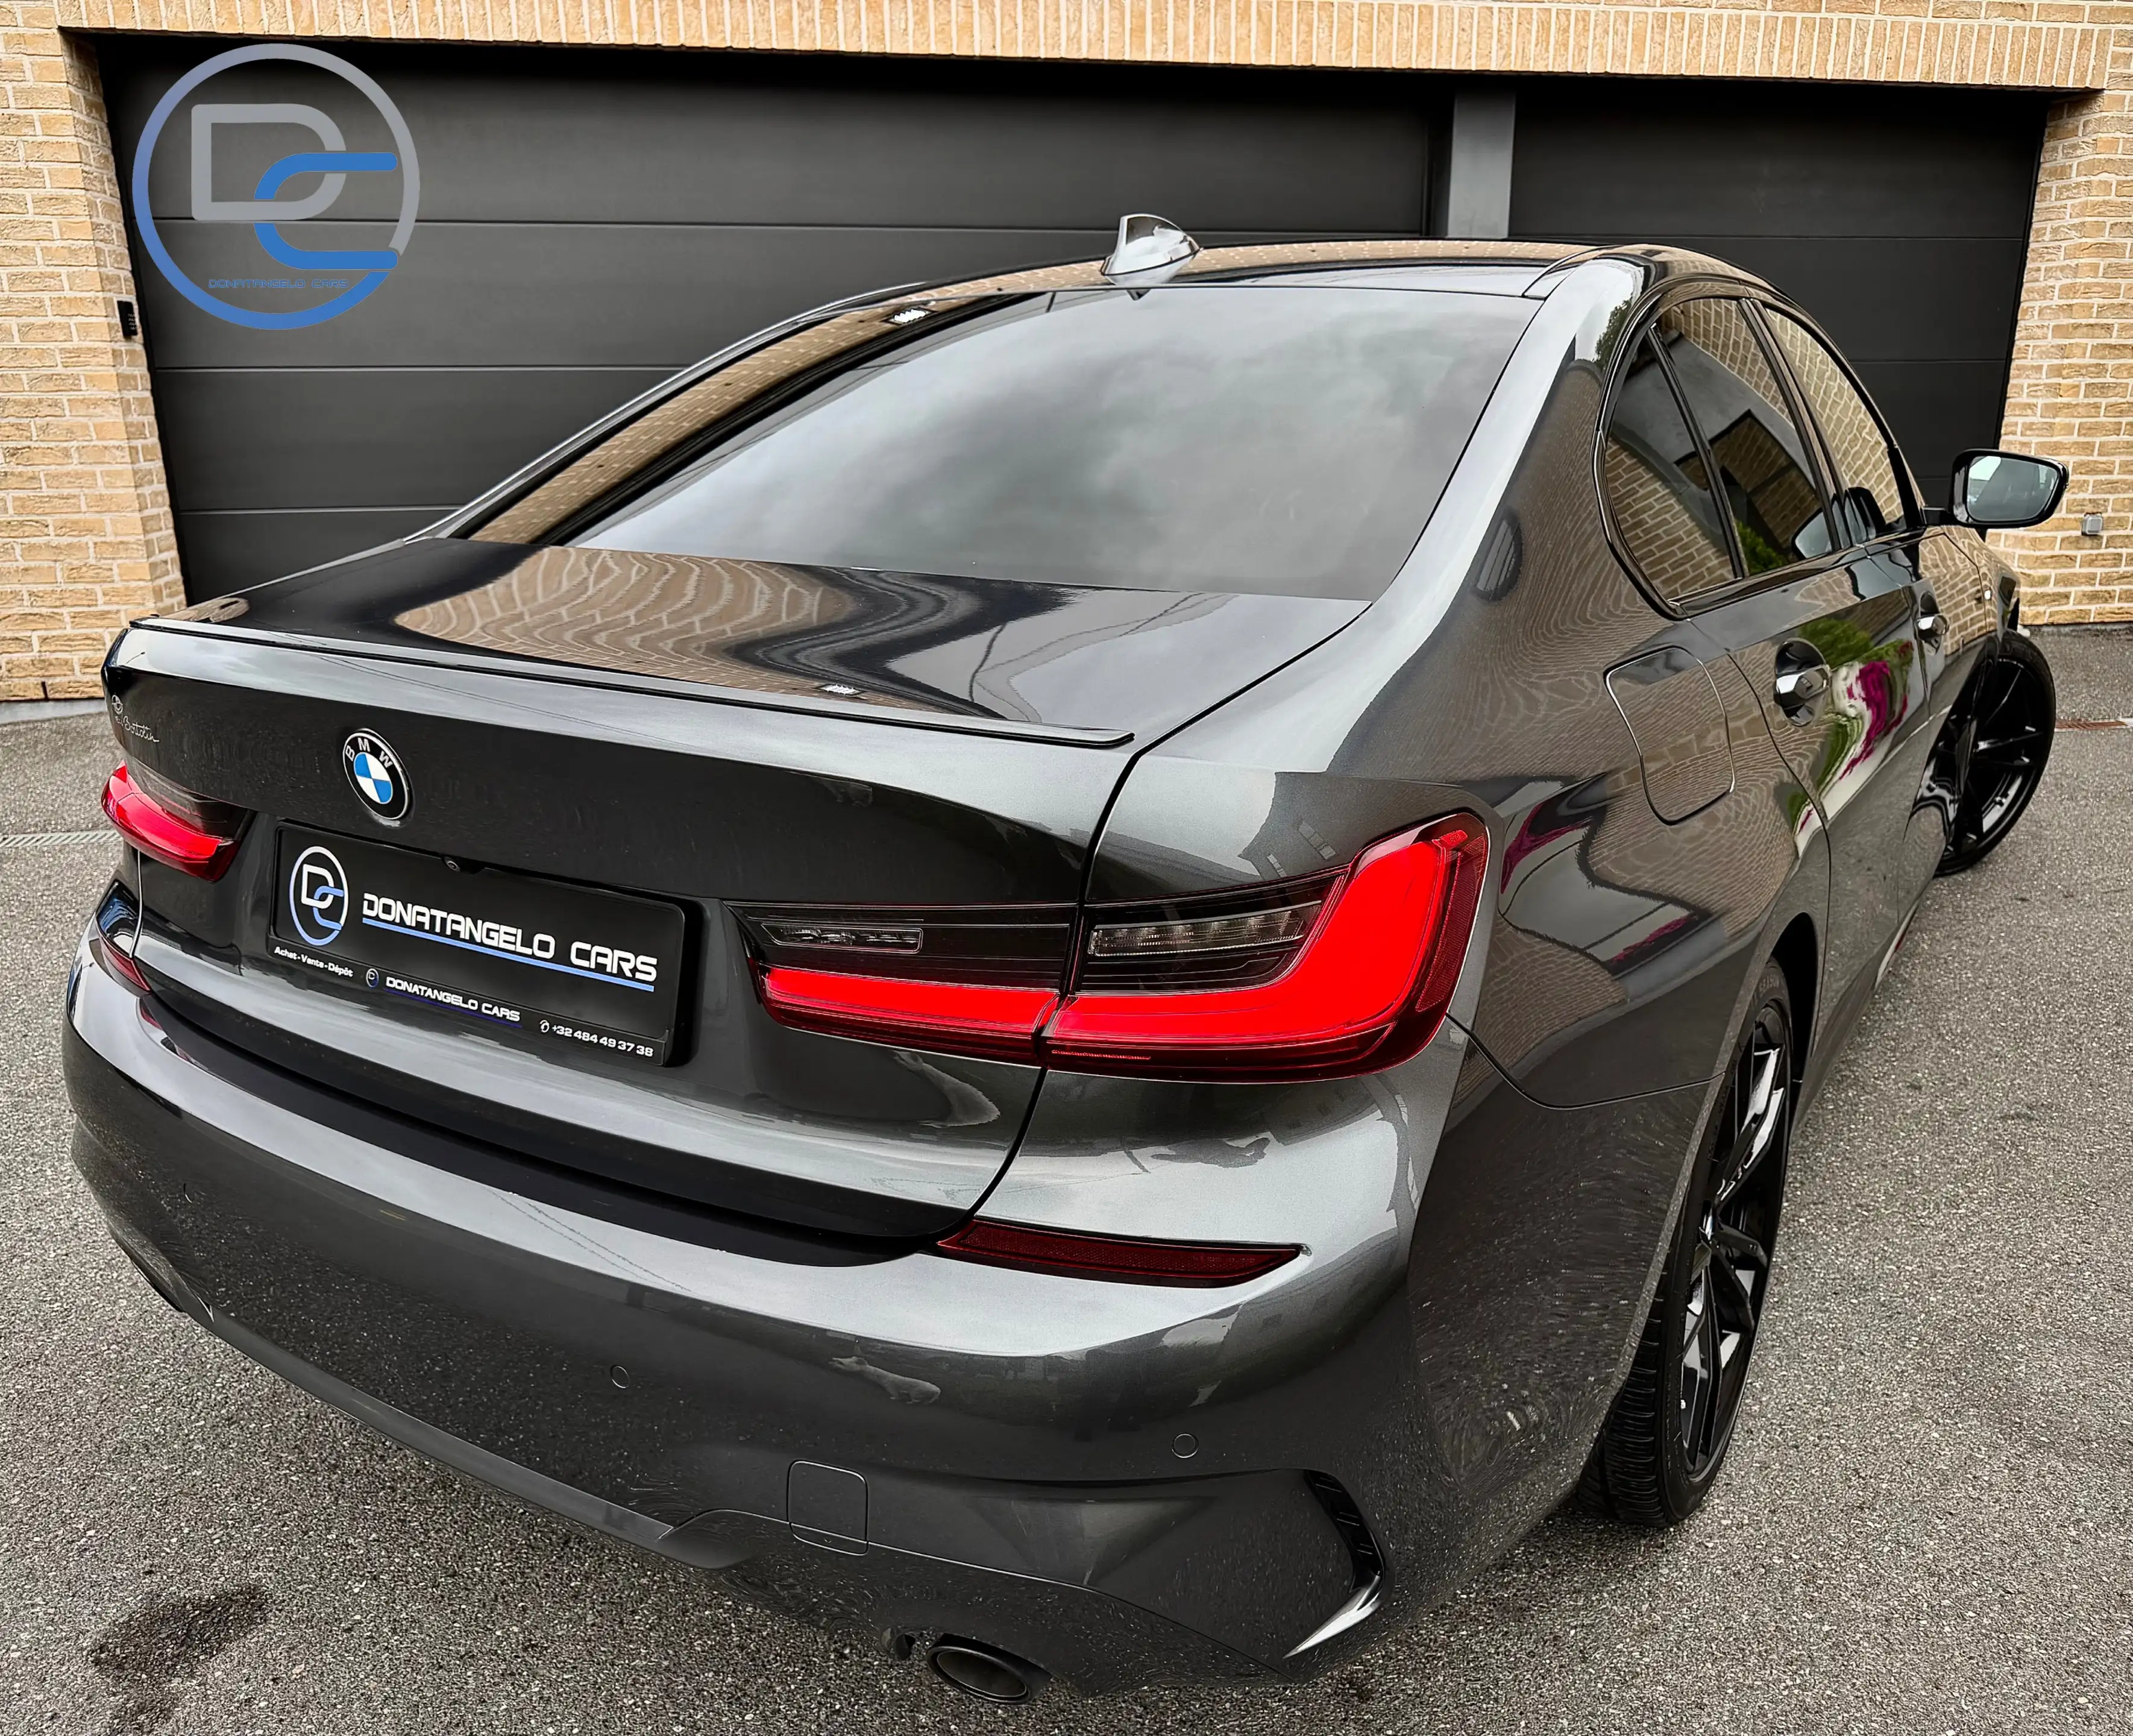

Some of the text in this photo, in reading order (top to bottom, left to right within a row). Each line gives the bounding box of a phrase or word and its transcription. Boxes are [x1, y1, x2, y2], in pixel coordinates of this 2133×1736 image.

[345, 737, 393, 769] BMW
[362, 893, 658, 982] DONATANGELO CARS
[386, 976, 520, 1022] DONATANGELO CARS
[551, 1025, 654, 1057] +32 484 49 37 38
